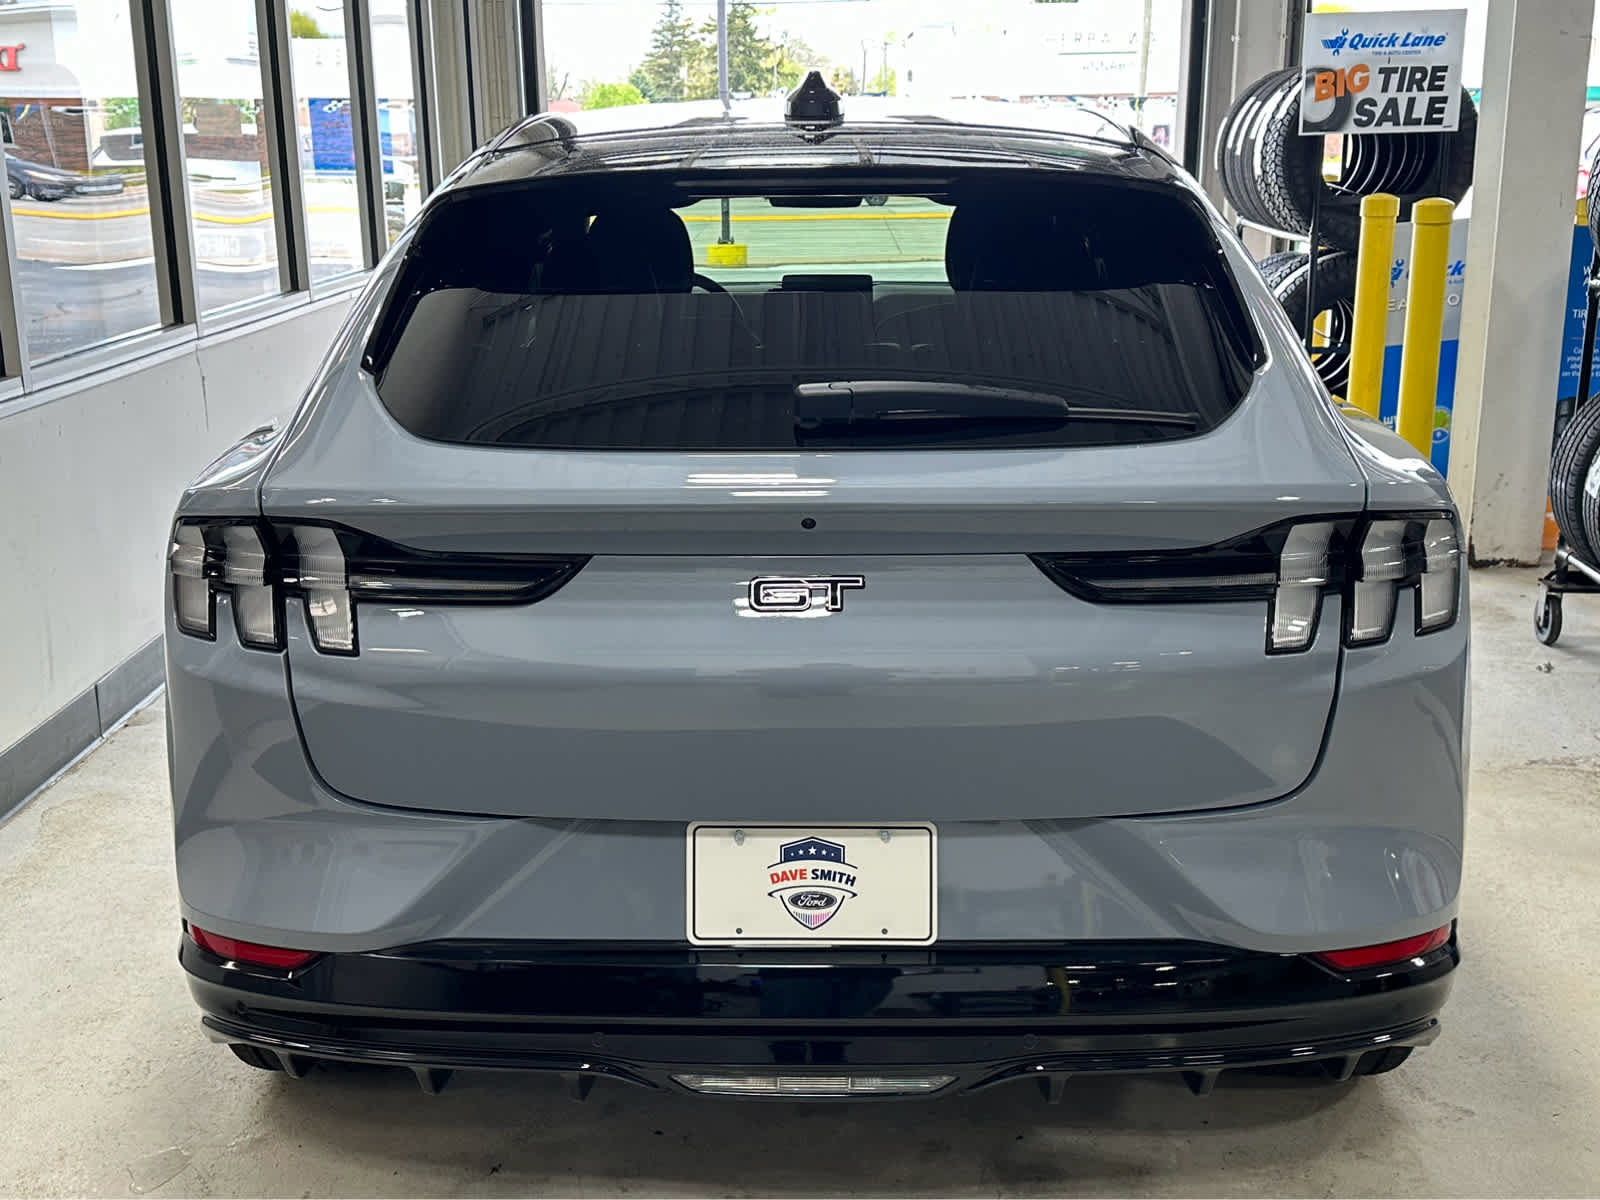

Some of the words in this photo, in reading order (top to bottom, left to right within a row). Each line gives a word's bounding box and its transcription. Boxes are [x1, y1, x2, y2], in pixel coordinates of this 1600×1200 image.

[1349, 32, 1400, 50] Quick
[1400, 32, 1446, 47] Lane
[1314, 63, 1370, 102] BIG
[1378, 65, 1449, 93] TIRE
[1353, 96, 1449, 128] SALE
[748, 574, 865, 613] GT
[769, 868, 808, 885] DAVE
[811, 868, 857, 887] SMITH
[796, 893, 828, 908] Ford
